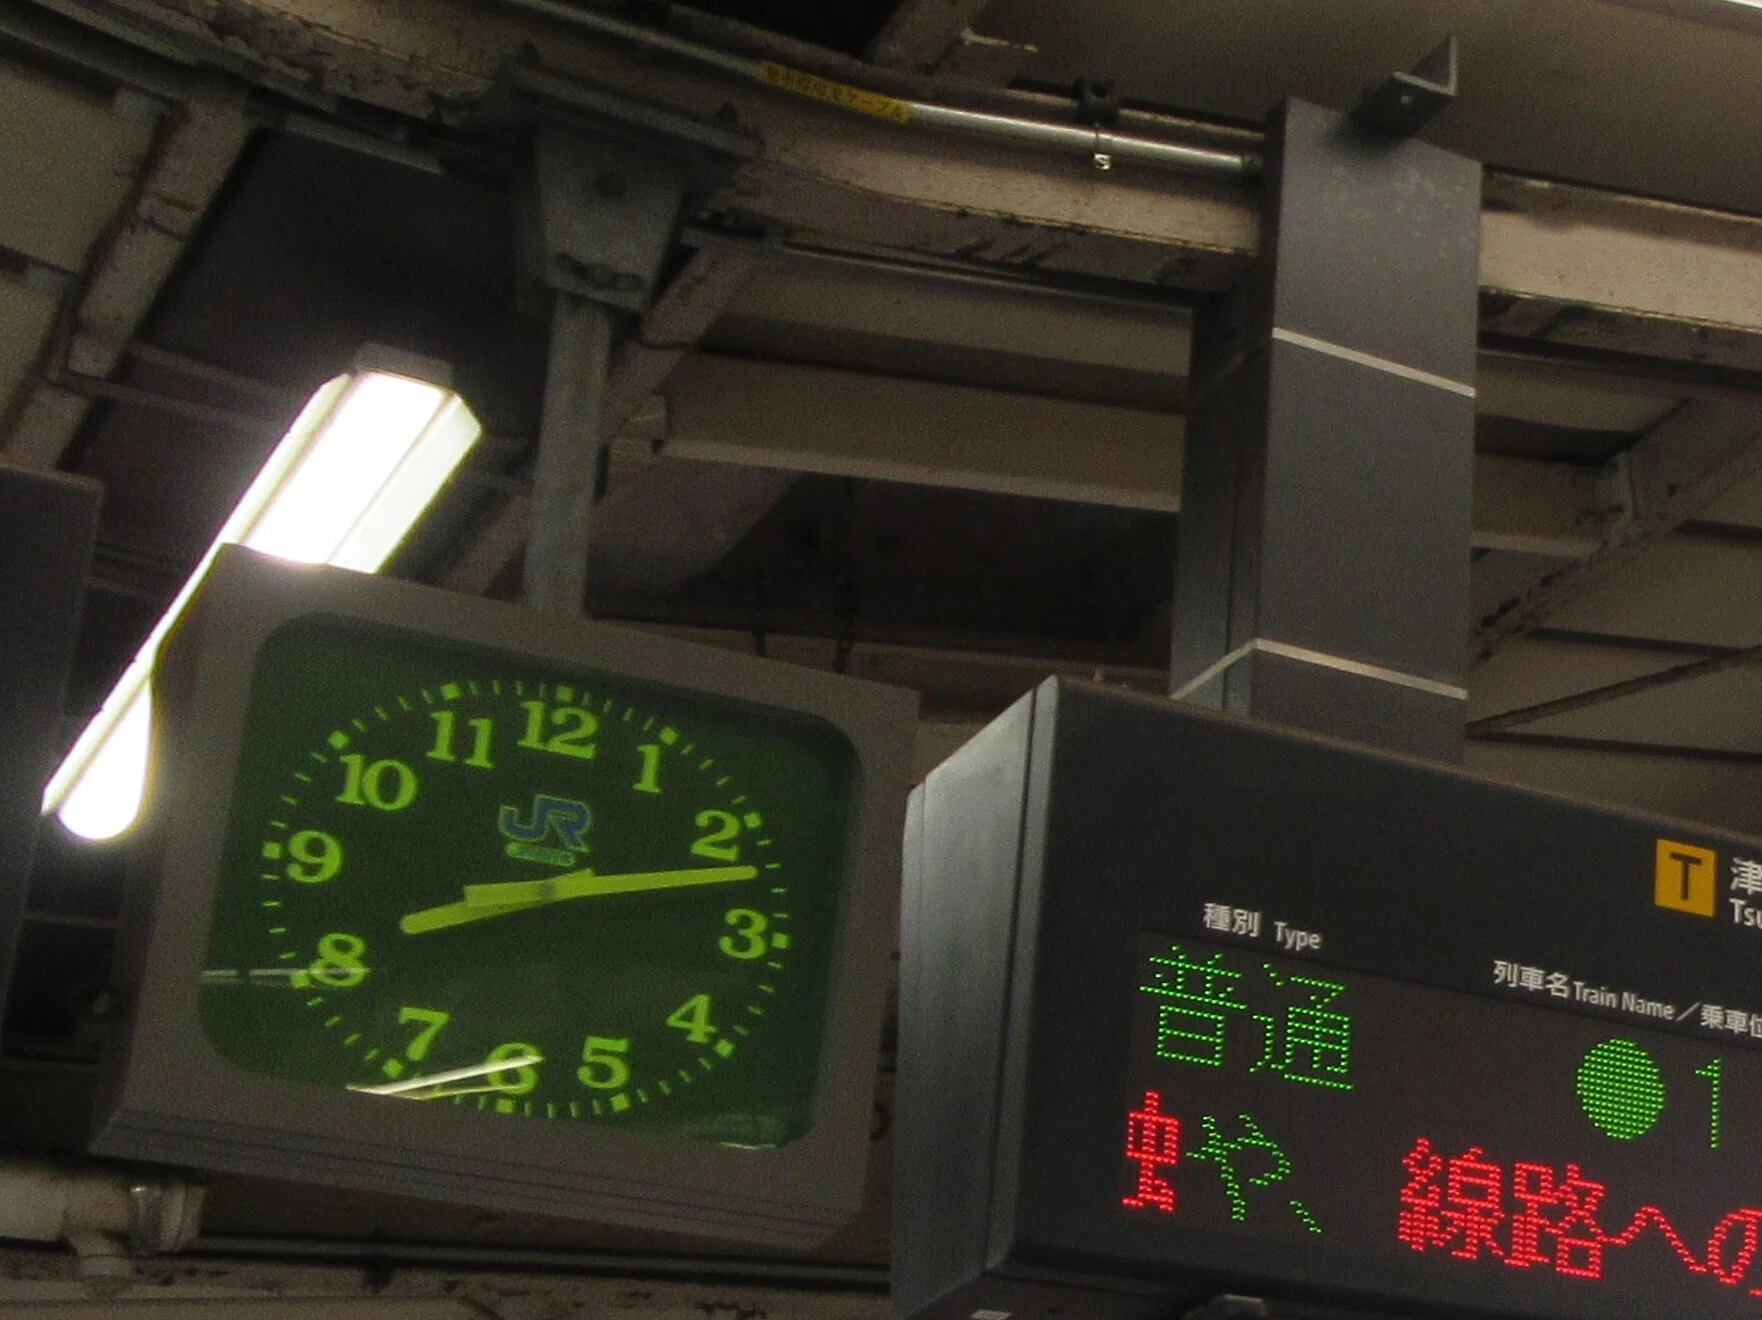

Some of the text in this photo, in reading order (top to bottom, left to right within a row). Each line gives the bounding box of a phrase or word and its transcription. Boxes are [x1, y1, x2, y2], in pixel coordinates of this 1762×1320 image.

[427, 710, 495, 769] 11
[517, 701, 599, 760] 12
[335, 754, 419, 811] 10
[632, 744, 665, 794] 1
[499, 794, 592, 854] JR
[690, 809, 743, 861] 2
[286, 831, 343, 883] 9
[719, 908, 769, 959] 3
[1202, 902, 1323, 952] 種別 Type
[308, 933, 368, 987] 8
[1493, 959, 1570, 999] 列車名
[1572, 980, 1618, 1010] Train
[1621, 990, 1676, 1022] Name
[399, 1006, 450, 1061] 7
[666, 994, 718, 1043] 4
[1138, 944, 1356, 1092] 普通
[486, 1042, 540, 1095] 6
[578, 1037, 631, 1089] 5
